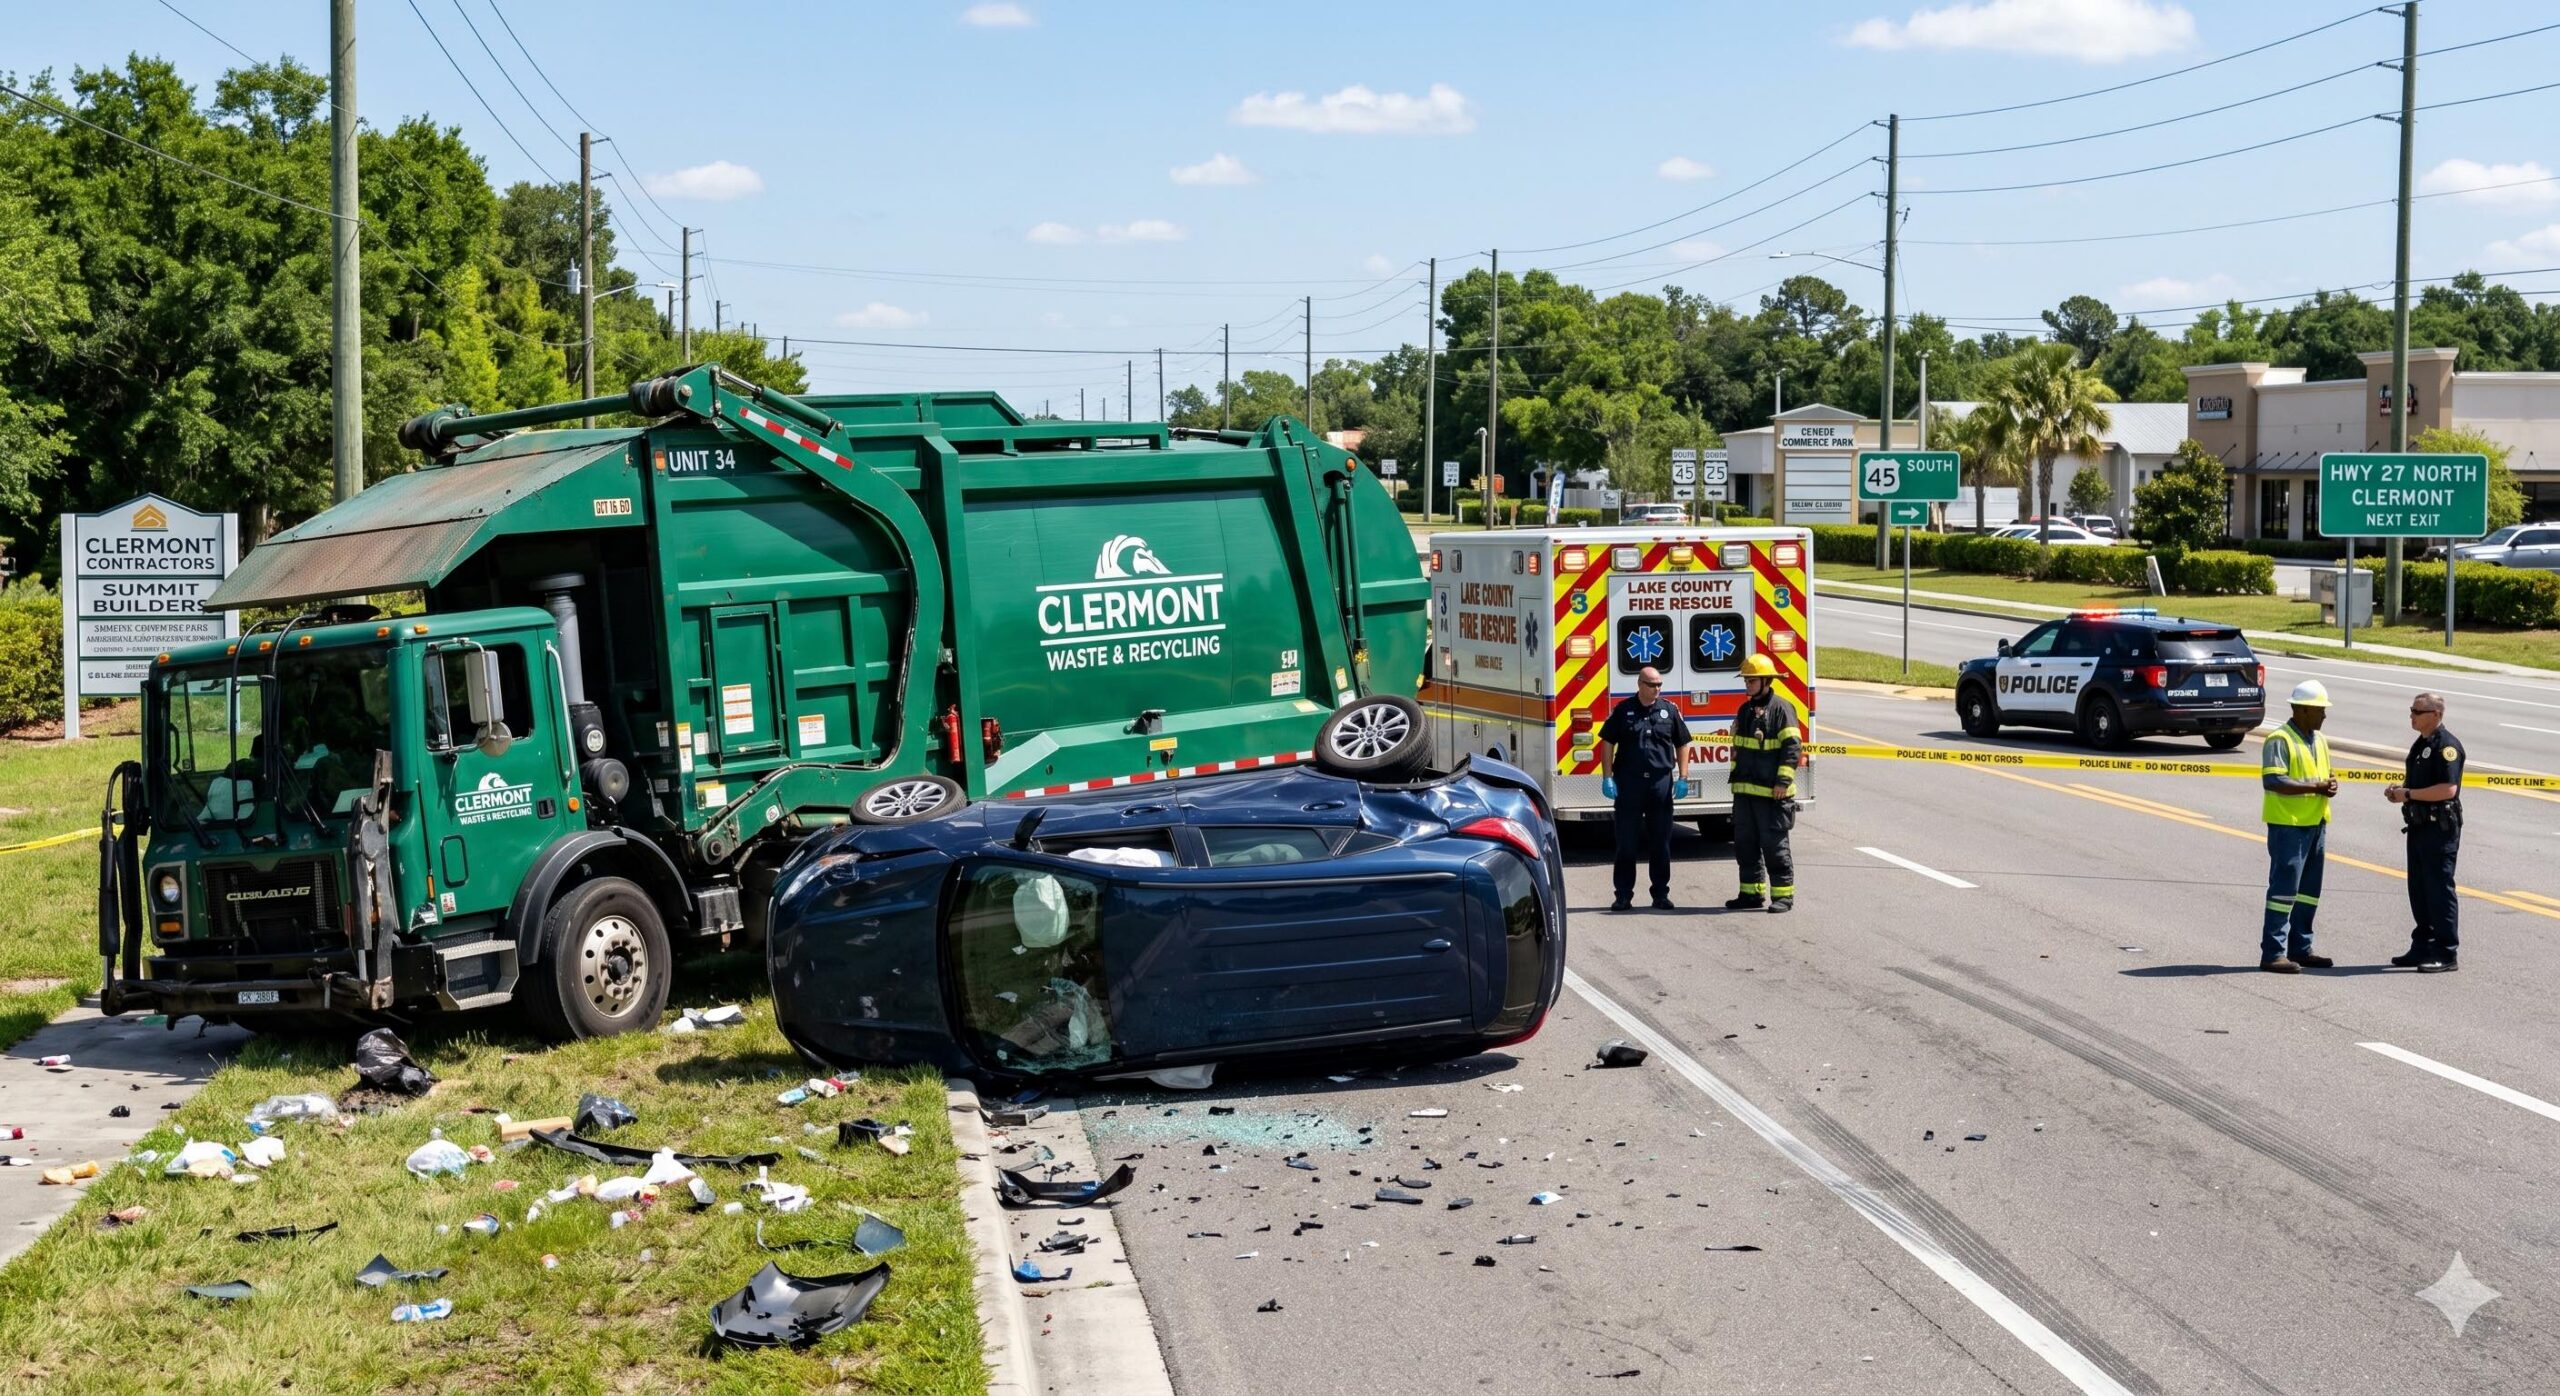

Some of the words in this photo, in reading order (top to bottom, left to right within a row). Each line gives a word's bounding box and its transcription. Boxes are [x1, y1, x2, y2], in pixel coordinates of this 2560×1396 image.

[1782, 438, 1829, 446] COMMERCE
[1832, 438, 1854, 446] PARK
[670, 450, 709, 472] UNIT
[715, 450, 736, 470] 34
[1907, 459, 1953, 472] SOUTH
[1676, 466, 1694, 480] 45
[1706, 466, 1725, 480] 25
[1868, 468, 1896, 487] 45
[2331, 464, 2373, 481] HWY
[2381, 464, 2406, 482] 27
[2413, 465, 2477, 482] NORTH
[2352, 488, 2455, 506] CLERMONT
[2366, 513, 2403, 526] NEXT
[2410, 514, 2440, 526] EXIT
[86, 538, 216, 554] CLERMONT
[86, 558, 215, 570] CONTRACTORS
[103, 583, 200, 596] SUMMIT
[1628, 582, 1666, 594] LAKE
[1671, 580, 1732, 594] COUNTY
[1460, 582, 1480, 605] LAKE
[1482, 583, 1514, 608] COUNTY
[1774, 588, 1790, 608] 3
[1038, 583, 1224, 635] CLERMONT
[1571, 592, 1588, 614] 3
[1628, 598, 1664, 611] FIRE
[1670, 596, 1733, 610] RESCUE
[1459, 612, 1479, 640] FIRE
[1480, 613, 1517, 645] RESCUE
[1046, 646, 1108, 672] WASTE
[1112, 645, 1124, 665] &
[1129, 634, 1220, 664] RECYCLING
[2010, 676, 2079, 694] POLICE
[1688, 745, 1731, 764] ANC
[1819, 746, 1847, 754] CROSS
[1928, 752, 1948, 760] LINE
[1960, 753, 1972, 761] DO
[1974, 754, 1992, 762] NOT
[2079, 759, 2110, 768] POLICE
[2112, 761, 2132, 770] LINE
[2146, 762, 2158, 770] DO
[2160, 763, 2178, 772] NOT
[2180, 764, 2210, 773] CROSS
[2348, 771, 2361, 779] DO
[2364, 772, 2382, 780] NOT
[2385, 772, 2404, 780] CRO
[2488, 776, 2522, 786] POLICE
[2524, 778, 2546, 786] LINE
[455, 788, 532, 812] CLERMONT
[460, 814, 486, 825] WASTE
